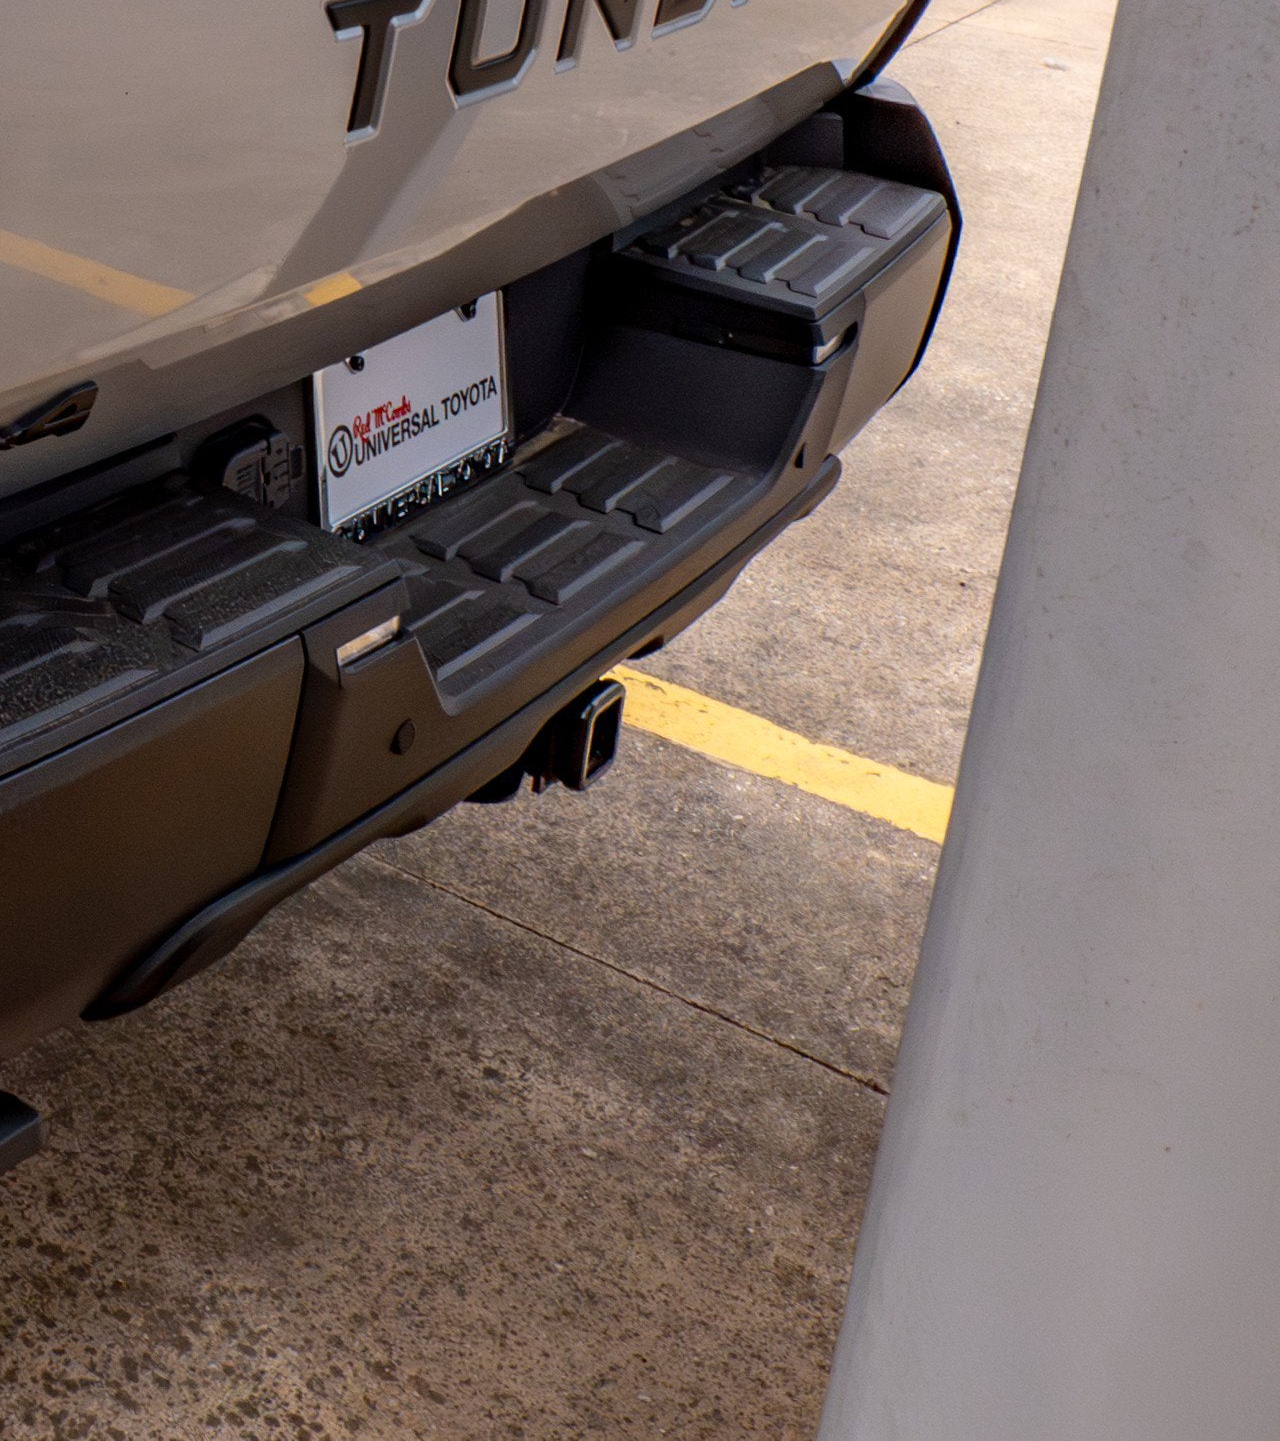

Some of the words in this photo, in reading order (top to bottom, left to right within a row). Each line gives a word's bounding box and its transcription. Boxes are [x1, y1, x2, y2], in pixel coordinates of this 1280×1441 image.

[353, 411, 371, 443] Red
[354, 404, 440, 467] UNIVERSAL
[441, 375, 498, 420] TOYOTA
